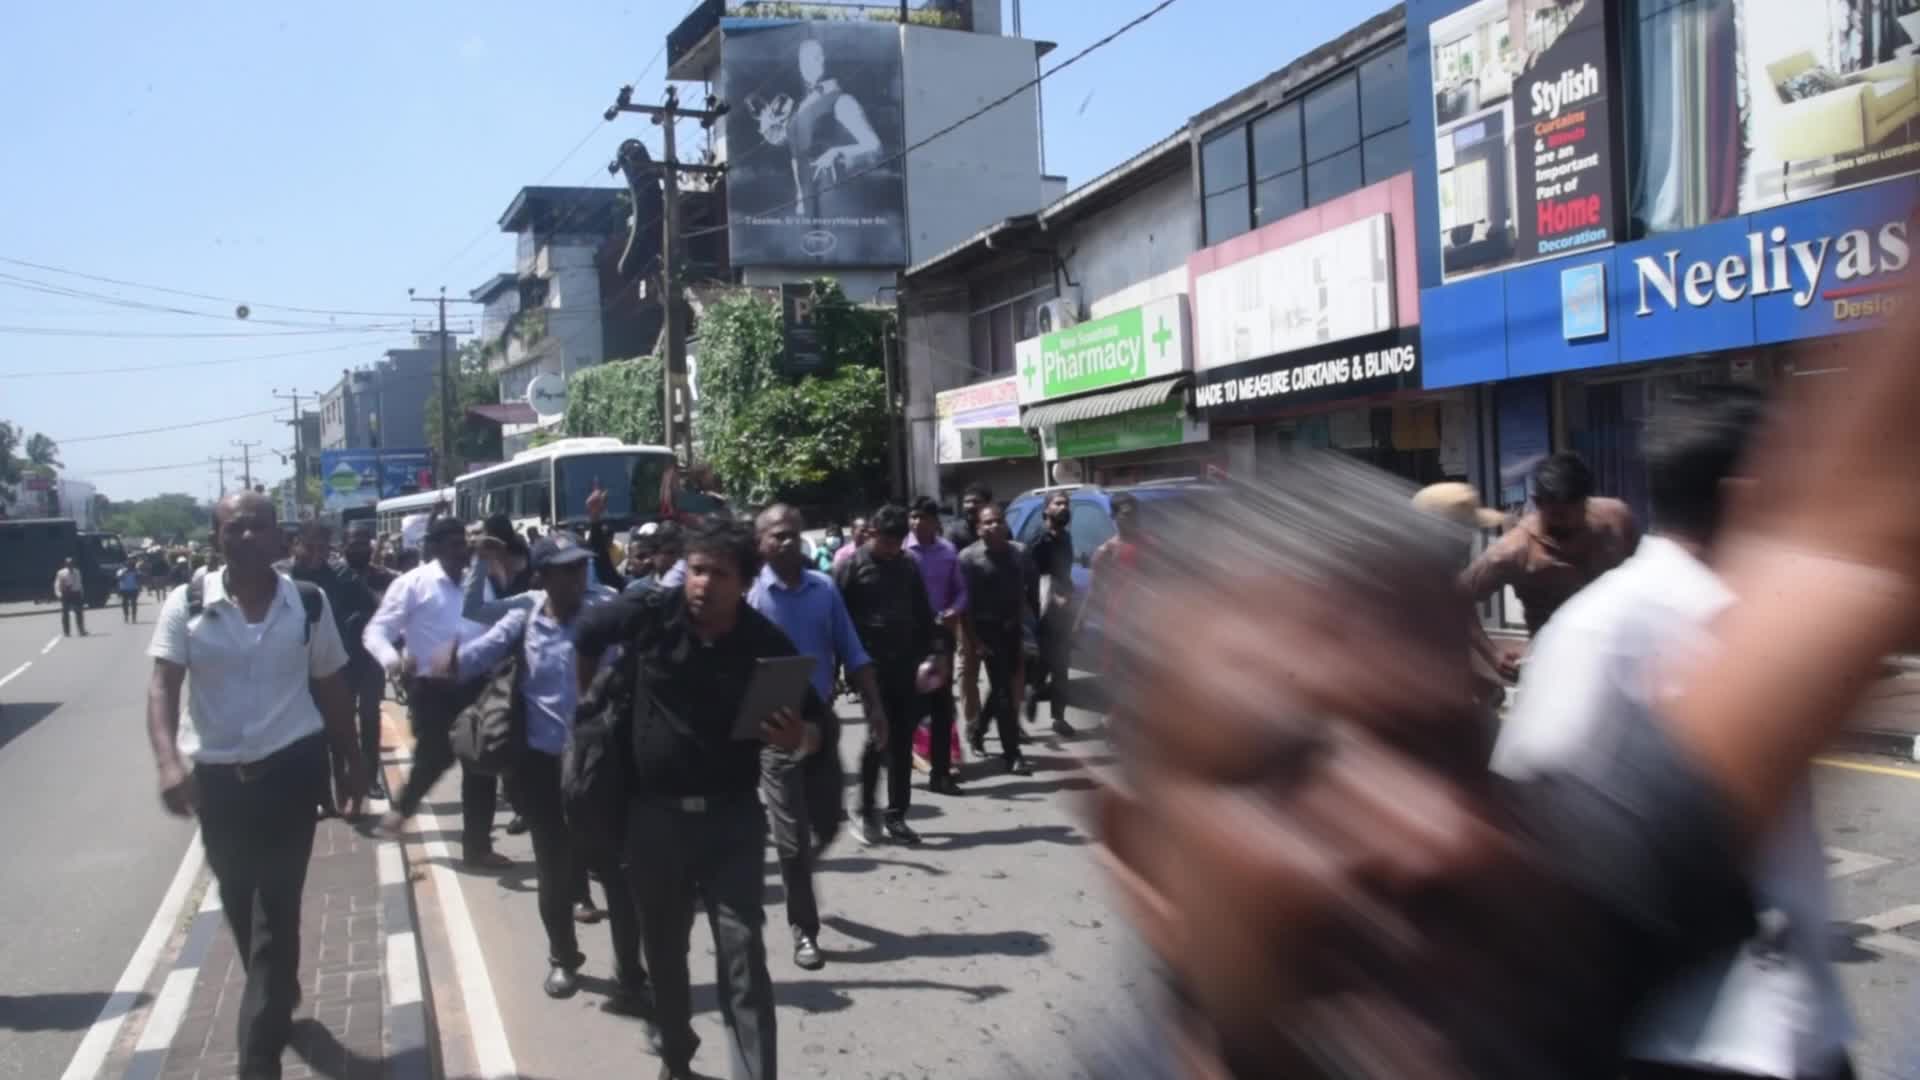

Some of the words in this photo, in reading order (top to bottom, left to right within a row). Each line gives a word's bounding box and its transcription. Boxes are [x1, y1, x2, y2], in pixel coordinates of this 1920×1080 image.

[1531, 62, 1599, 119] Stylish
[1534, 138, 1544, 153] &
[1535, 151, 1556, 166] are
[1557, 145, 1574, 159] an
[1535, 152, 1599, 182] Important
[1536, 183, 1562, 201] Part
[1563, 176, 1578, 193] of
[1536, 193, 1601, 238] Home
[1537, 227, 1607, 254] Decoration
[1633, 221, 1911, 317] Neeliyas
[1043, 334, 1142, 386] Pharmacy
[1195, 379, 1223, 408] MADE
[1224, 378, 1237, 403] TO
[1238, 368, 1290, 401] MEASURE
[1291, 357, 1350, 392] CURTAINS
[1352, 354, 1363, 381] &
[1364, 345, 1415, 378] BLINDS
